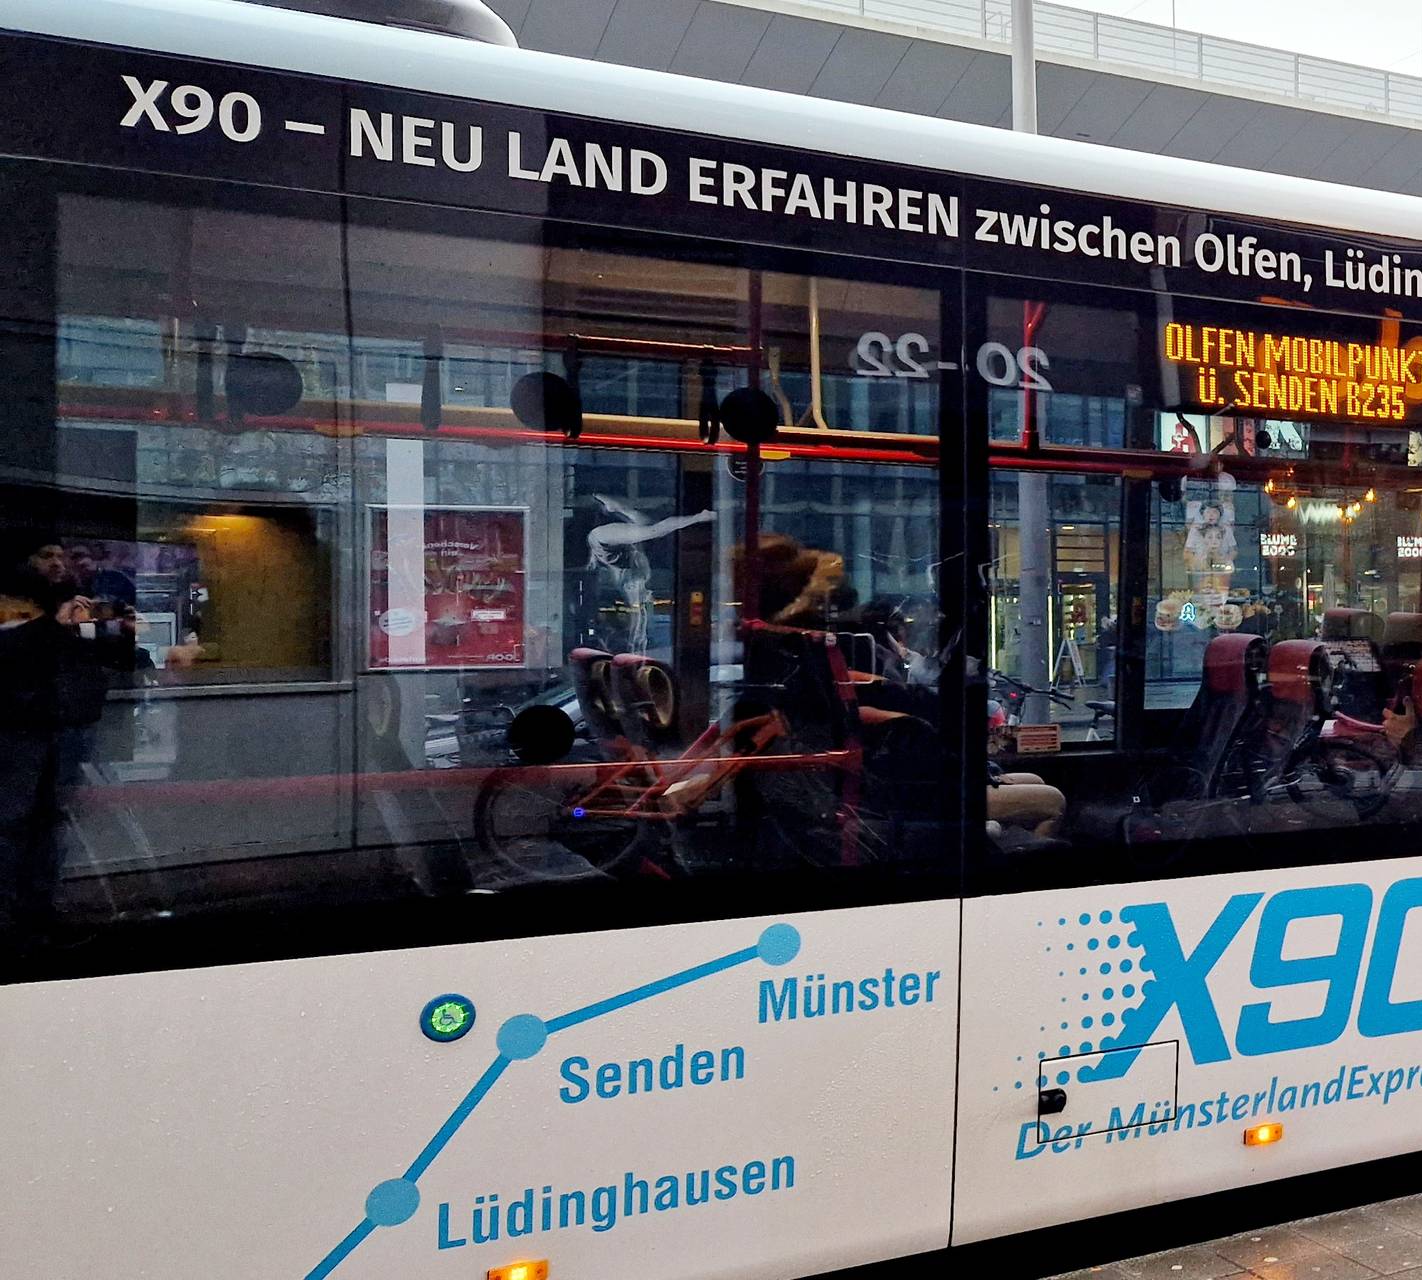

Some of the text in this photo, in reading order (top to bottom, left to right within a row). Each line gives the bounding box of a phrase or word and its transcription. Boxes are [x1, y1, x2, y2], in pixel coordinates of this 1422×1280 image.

[119, 75, 262, 142] X90
[350, 107, 483, 172] NEU
[508, 131, 668, 195] LAND
[689, 157, 959, 238] ERFAHREN
[974, 203, 1181, 268] zwischen
[1194, 232, 1313, 292] Olfen,
[1165, 322, 1254, 367] OLFEN
[1234, 370, 1337, 414] SENDEN
[1346, 381, 1405, 419] B235
[758, 969, 941, 1025] Münster
[559, 1044, 746, 1105] Senden
[1014, 1120, 1093, 1161] Der
[437, 1154, 796, 1251] Lüdinghausen
